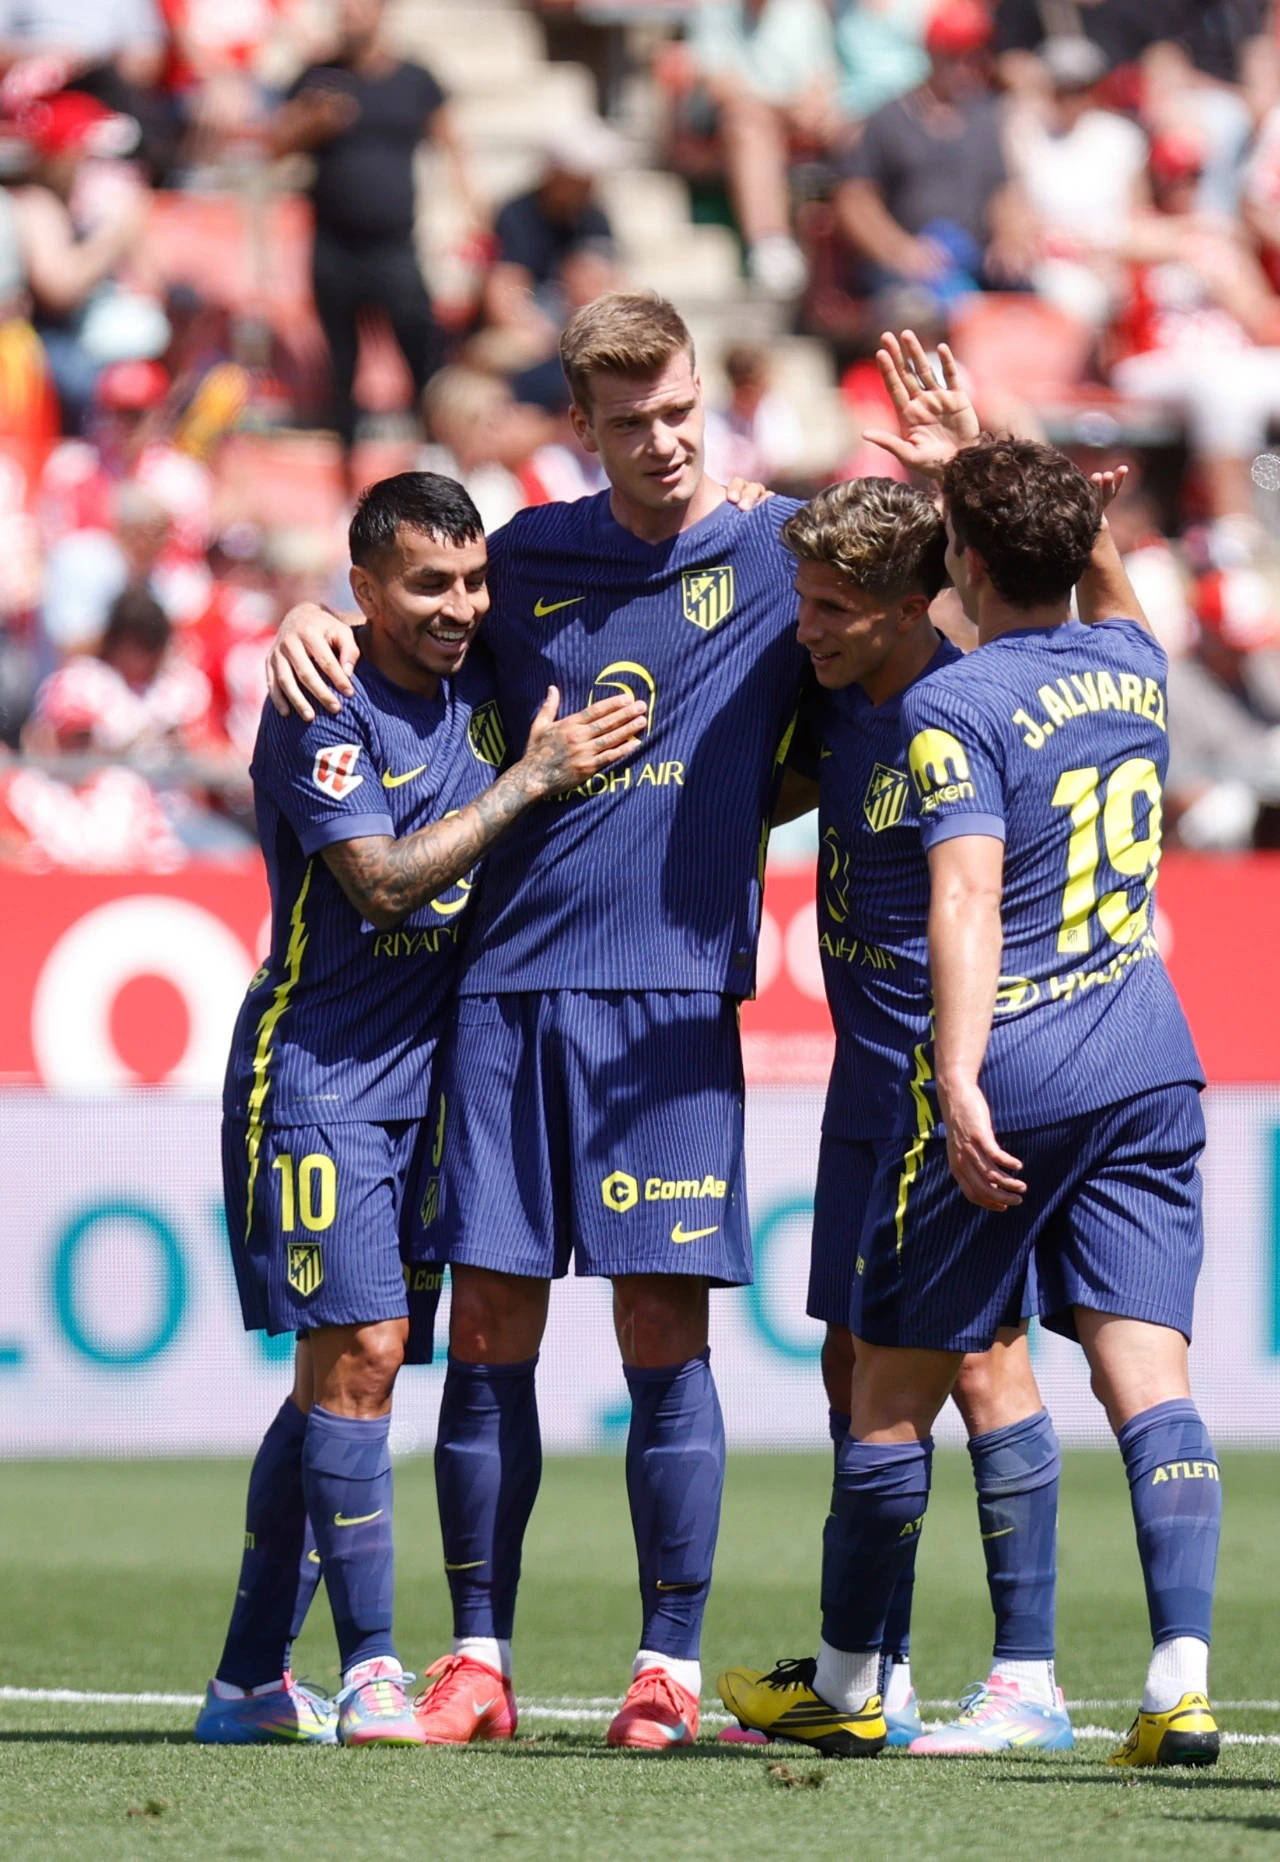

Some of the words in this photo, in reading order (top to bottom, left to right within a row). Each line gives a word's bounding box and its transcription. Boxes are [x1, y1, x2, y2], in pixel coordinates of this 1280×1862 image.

[636, 760, 685, 787] AIR
[1051, 757, 1162, 954] 19
[272, 1153, 337, 1233] 10
